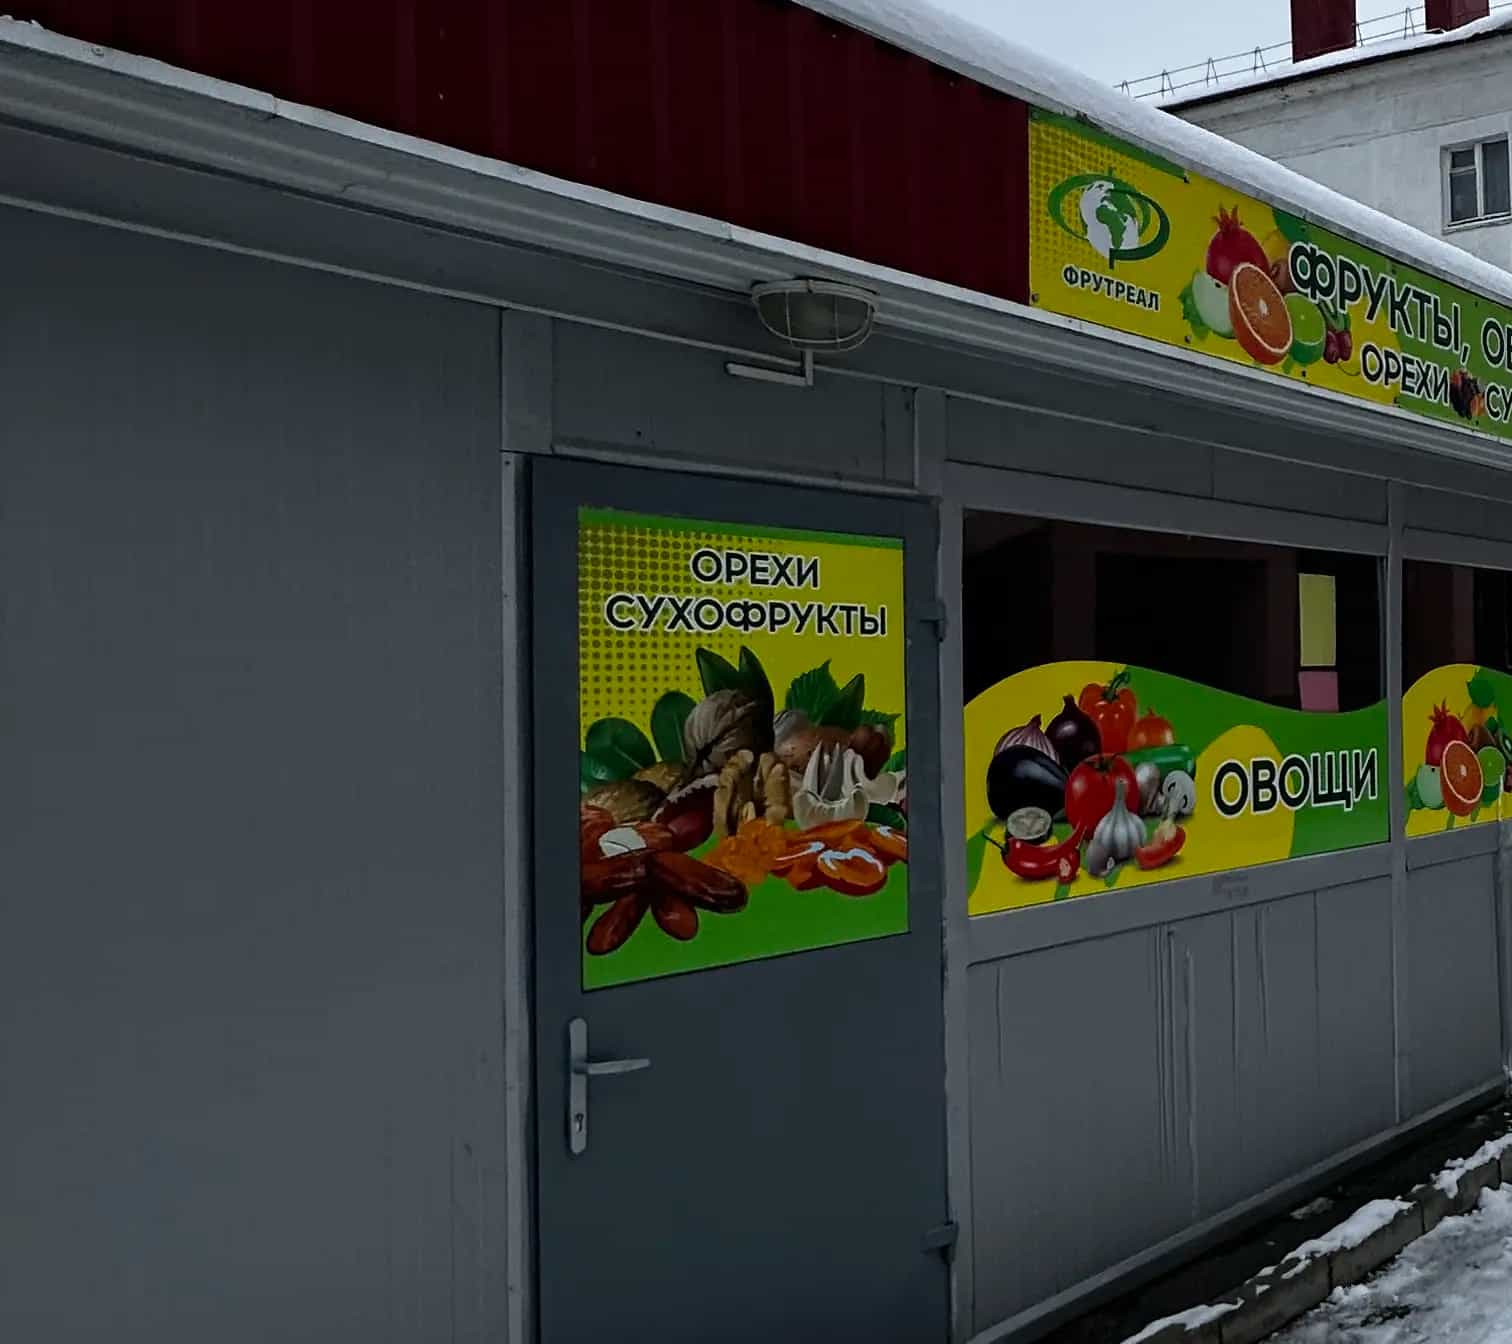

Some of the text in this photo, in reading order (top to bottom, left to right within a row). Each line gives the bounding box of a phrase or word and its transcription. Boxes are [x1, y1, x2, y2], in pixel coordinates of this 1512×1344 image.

[1063, 265, 1160, 312] ФРУТРЕАЛ
[1289, 242, 1470, 365] ФРУКТЫ,
[1360, 343, 1451, 406] ОРЕХИ
[690, 549, 820, 589] ОРЕХИ
[605, 593, 888, 637] СУХОФРУКТЫ
[1212, 748, 1377, 819] ОВОЩИ
